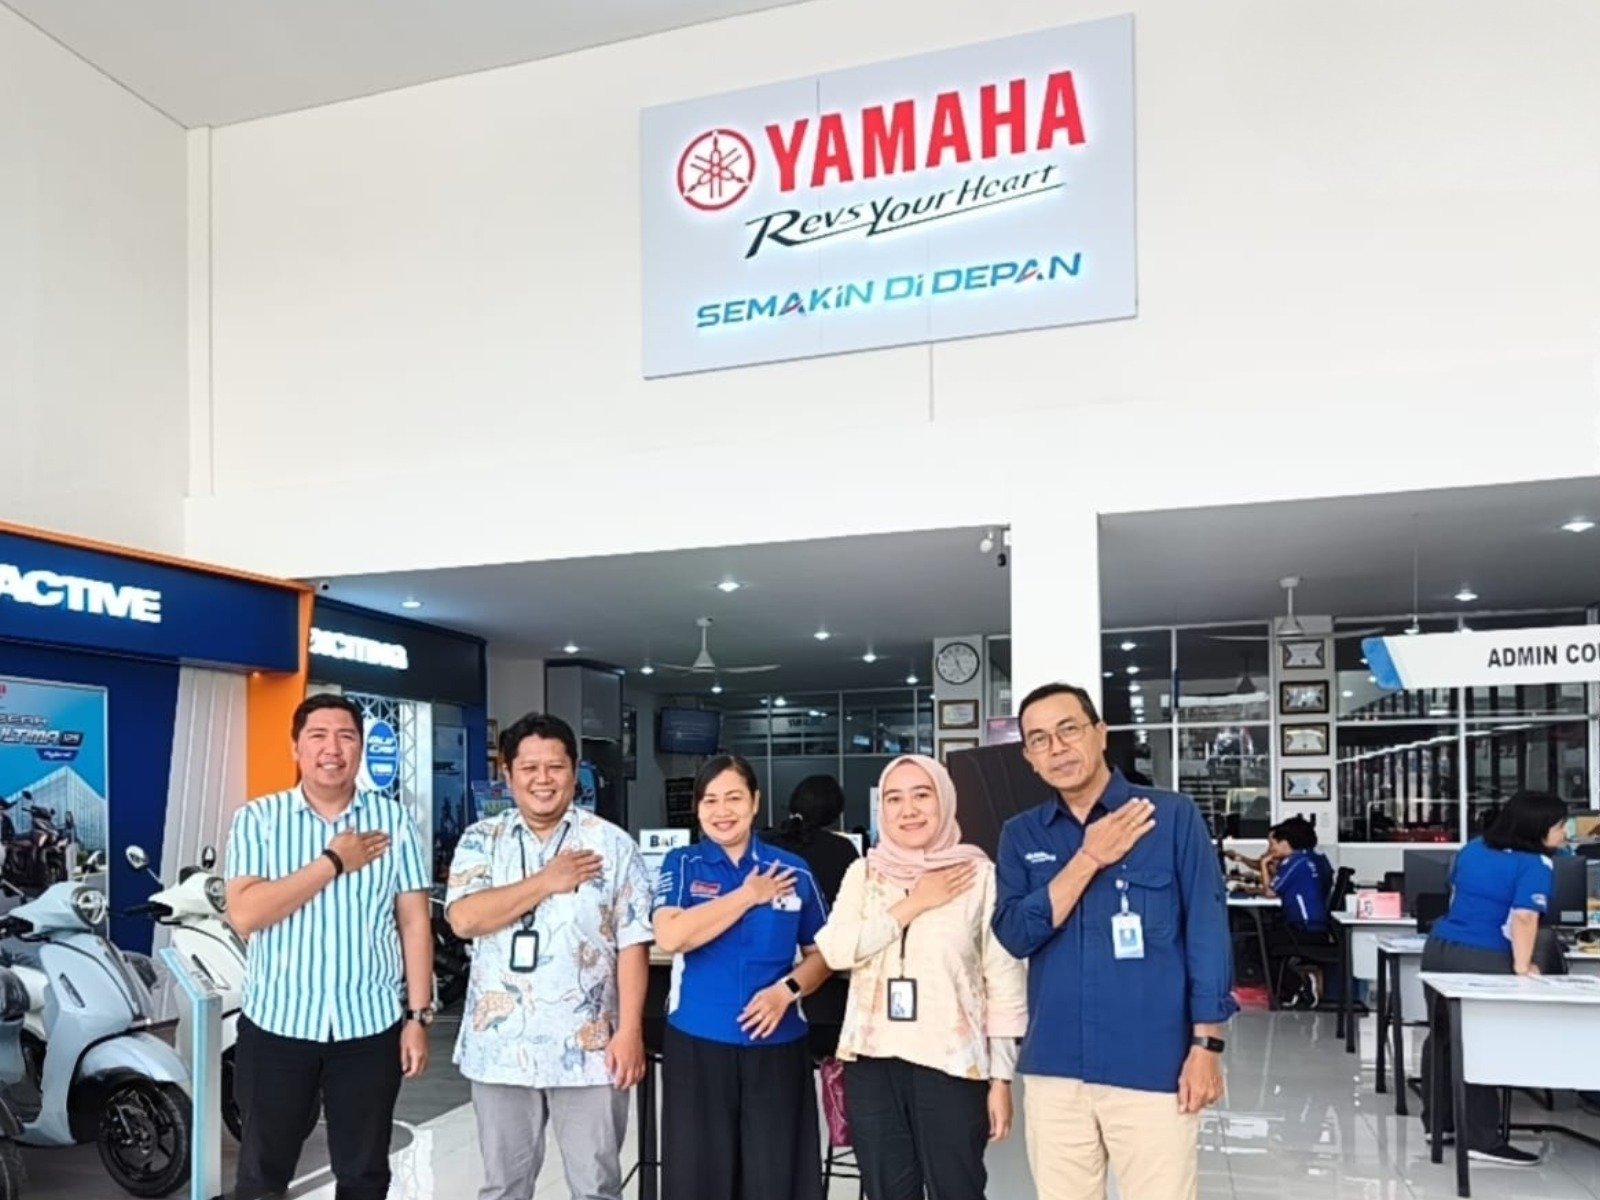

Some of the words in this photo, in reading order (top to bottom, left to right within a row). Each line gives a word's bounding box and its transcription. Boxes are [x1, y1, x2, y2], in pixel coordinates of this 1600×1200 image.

[765, 70, 1086, 192] YAMAHA
[745, 202, 863, 259] Revs
[866, 189, 954, 237] Your
[956, 164, 1058, 206] Heart
[931, 252, 1082, 294] DEPAN
[1488, 645, 1558, 668] ADMIN
[1565, 643, 1600, 664] CO
